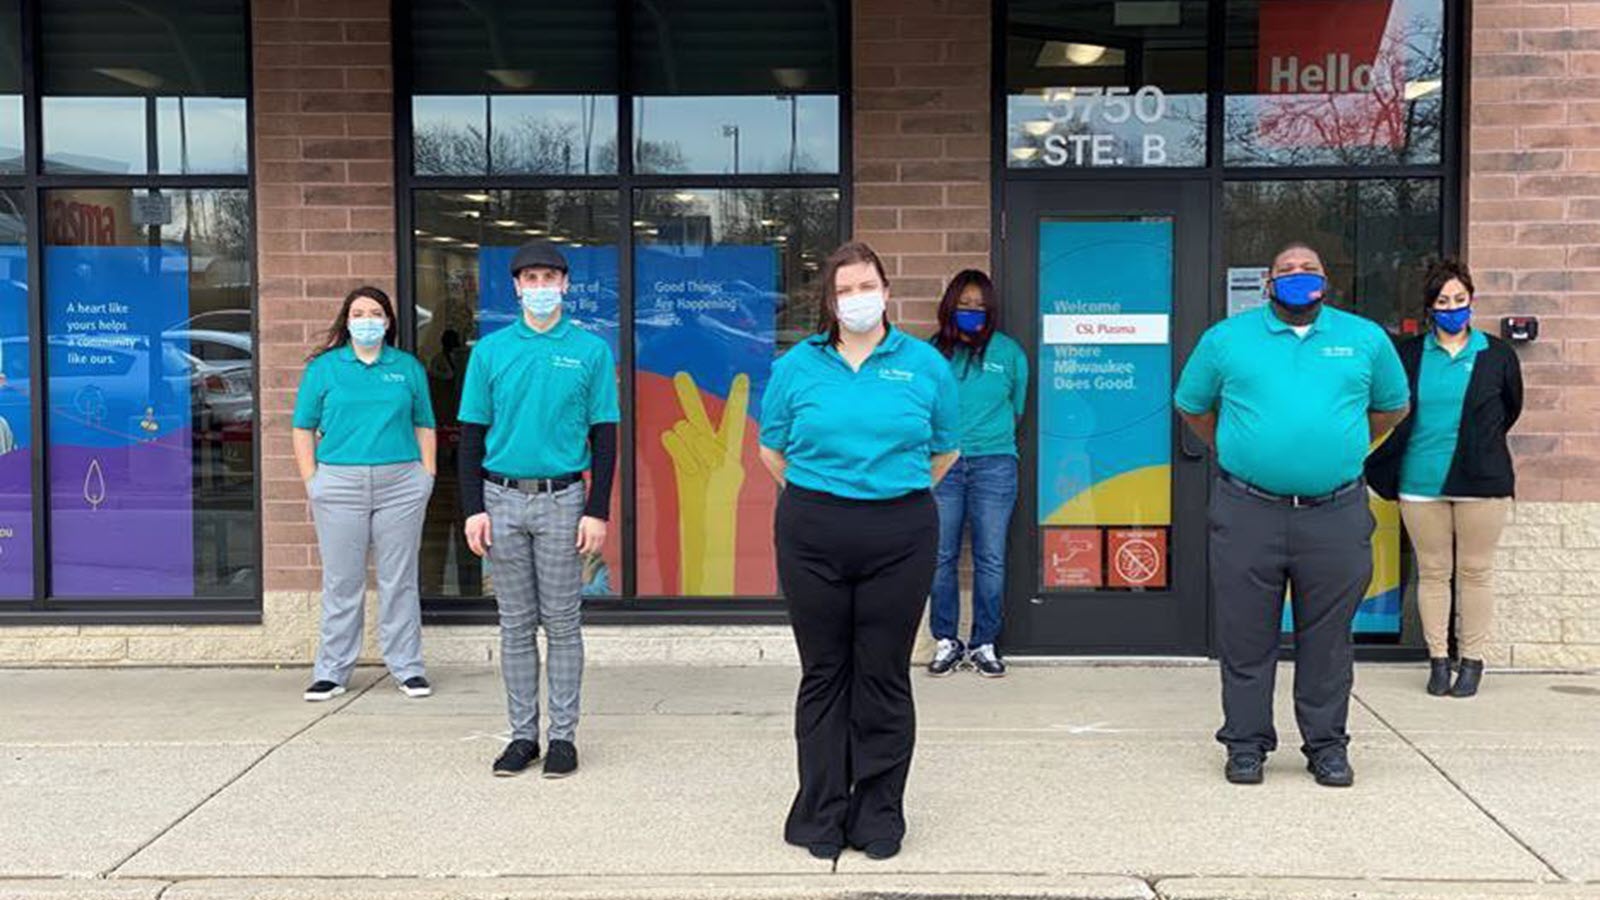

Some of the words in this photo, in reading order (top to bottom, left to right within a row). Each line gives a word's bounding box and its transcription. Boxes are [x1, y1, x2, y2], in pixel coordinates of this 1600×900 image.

[1270, 53, 1376, 92] Hello
[1045, 85, 1166, 123] 5750
[1042, 134, 1124, 166] STE.
[1142, 134, 1167, 166] B
[655, 281, 685, 293] Good
[687, 281, 723, 295] Things
[66, 302, 75, 314] A
[78, 302, 107, 314] heart
[108, 302, 129, 314] like
[677, 299, 738, 313] Happening
[1053, 300, 1121, 313] Welcome
[66, 321, 97, 333] yours
[98, 320, 128, 334] helps
[1097, 323, 1137, 335] Plasma
[77, 336, 137, 348] community
[68, 352, 89, 364] like
[89, 354, 115, 364] ours.
[1054, 346, 1102, 358] Where
[1053, 360, 1136, 374] Milwaukee
[1053, 377, 1092, 390] Does
[1093, 376, 1138, 390] Good.
